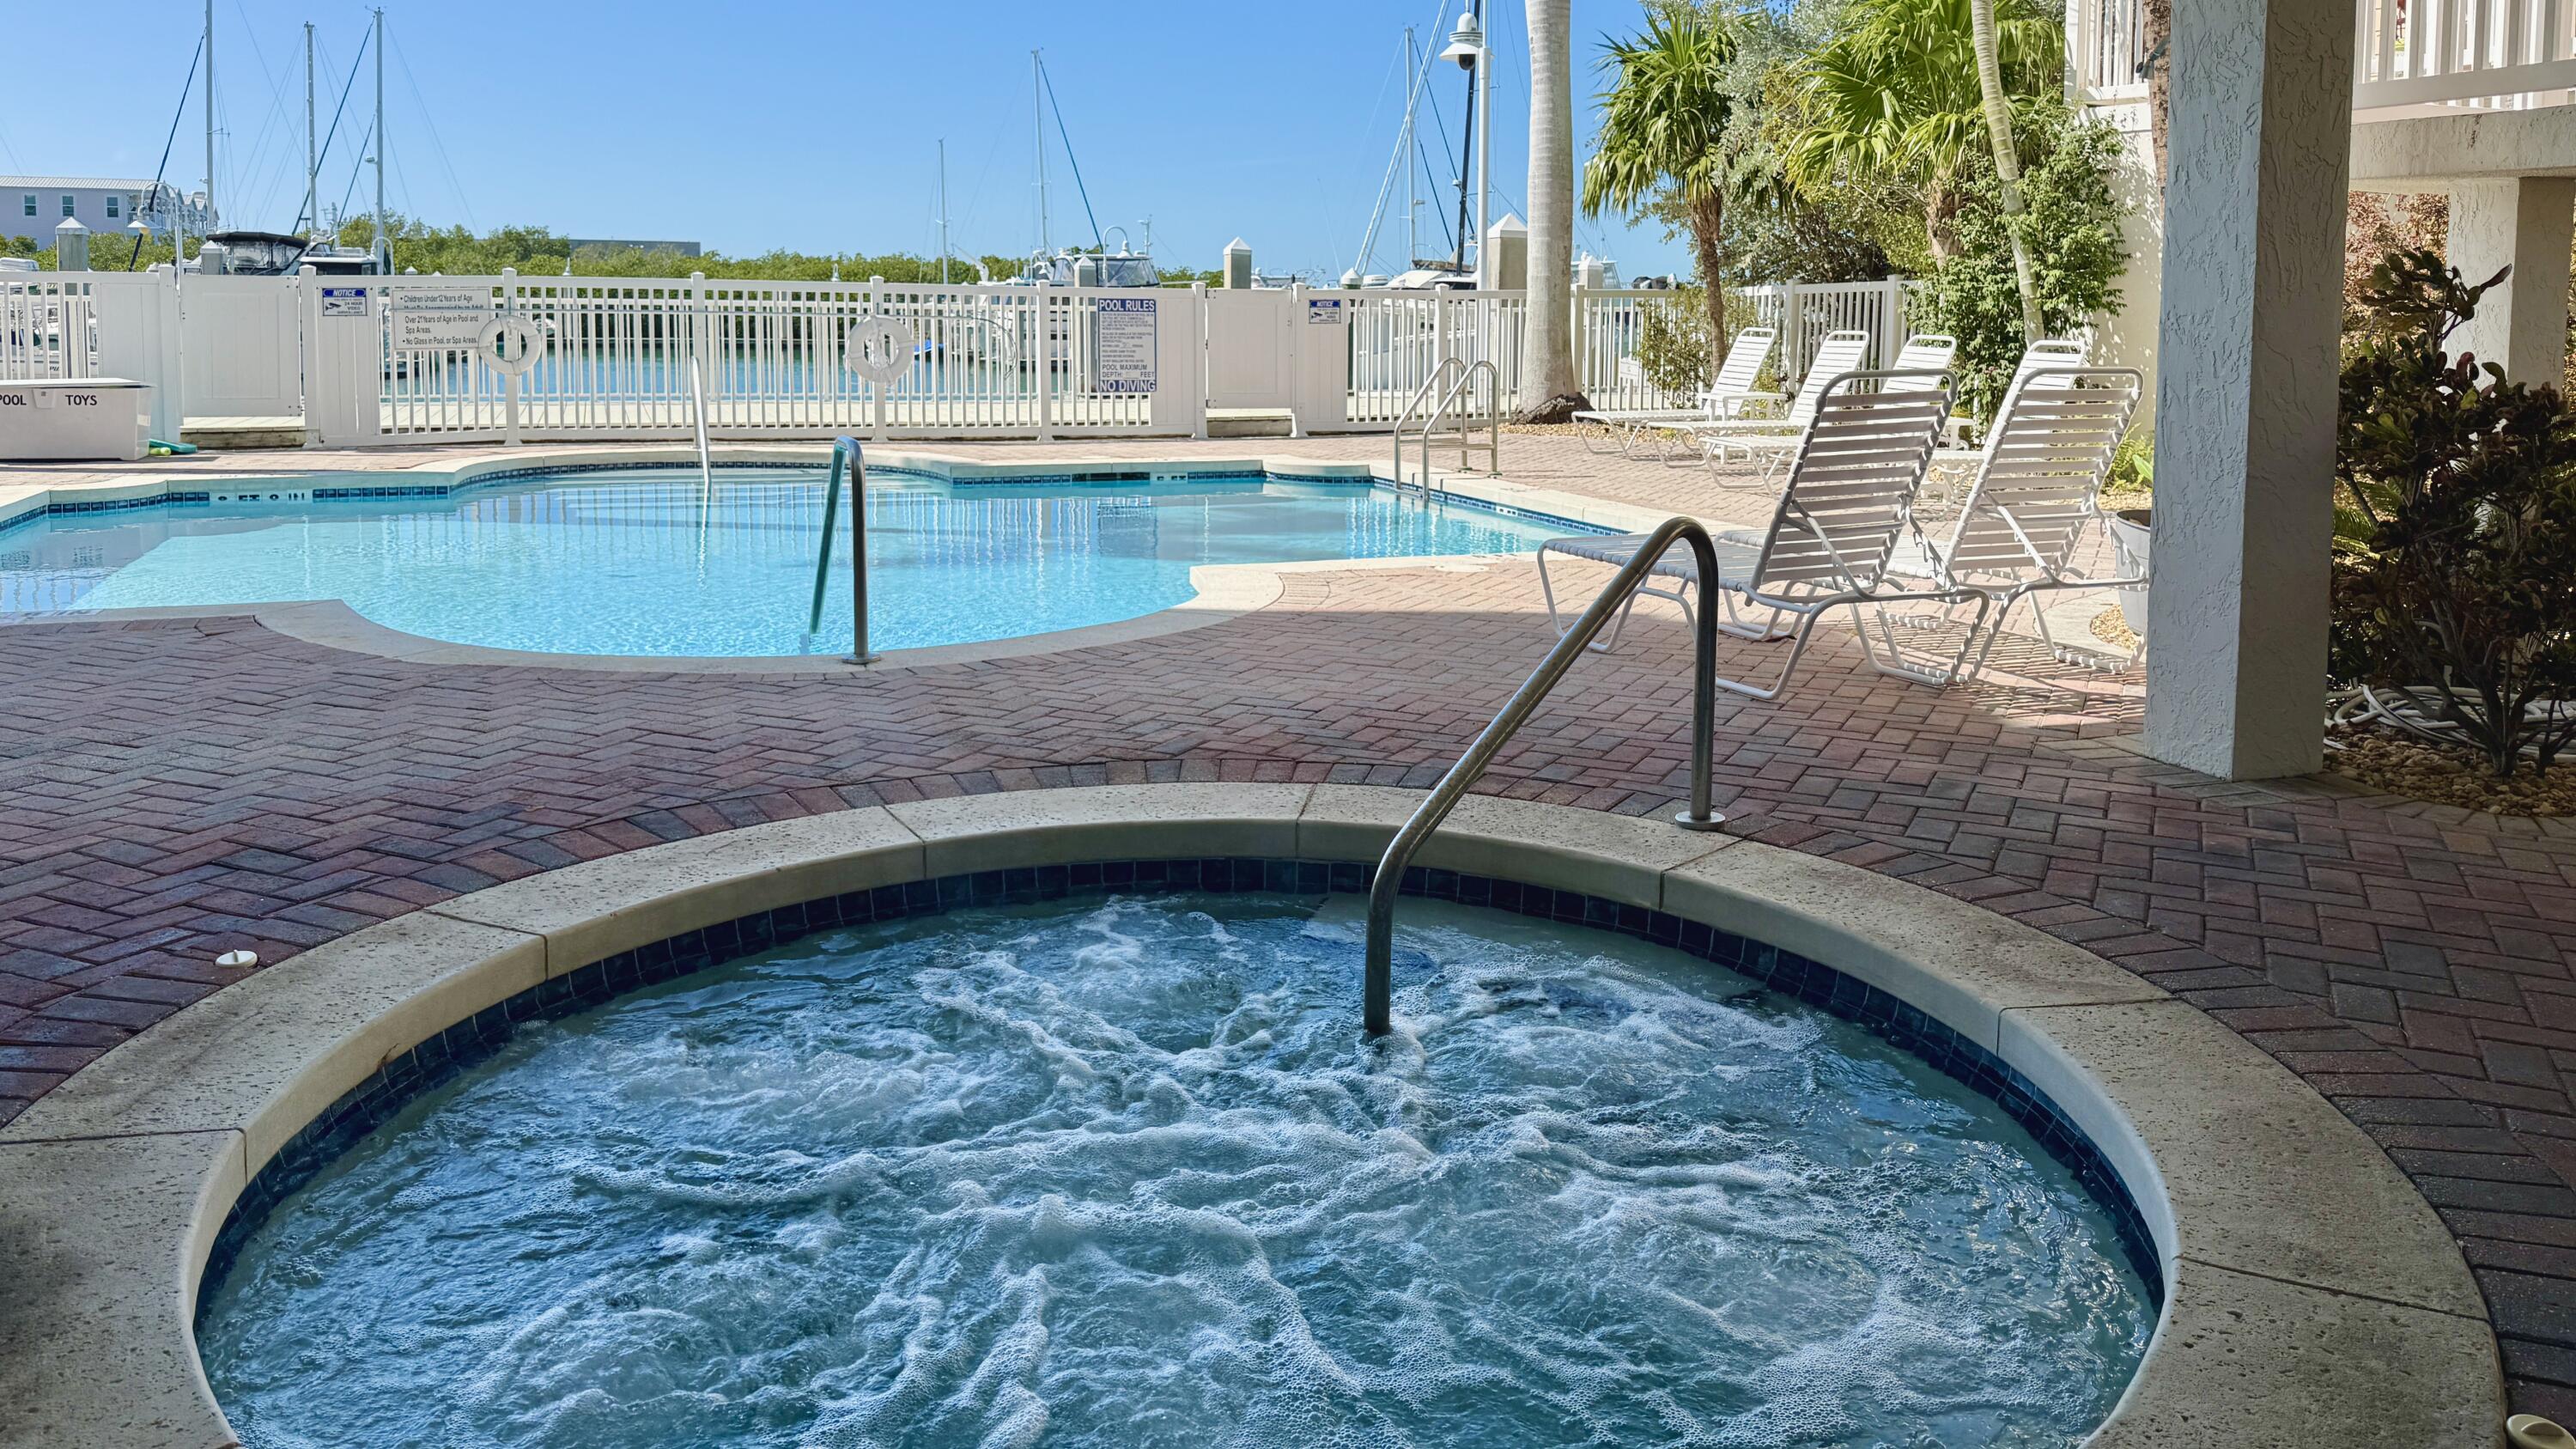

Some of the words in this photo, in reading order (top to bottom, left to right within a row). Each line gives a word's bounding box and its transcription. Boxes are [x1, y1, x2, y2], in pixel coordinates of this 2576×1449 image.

[463, 294, 473, 303] Age
[1099, 300, 1124, 311] POOL
[1126, 300, 1155, 311] RULES
[404, 315, 416, 324] Over
[442, 315, 453, 325] Age
[405, 326, 415, 335] Spa
[1099, 381, 1116, 392] NO
[1119, 381, 1156, 392] DIVING
[65, 394, 98, 406] TOYS
